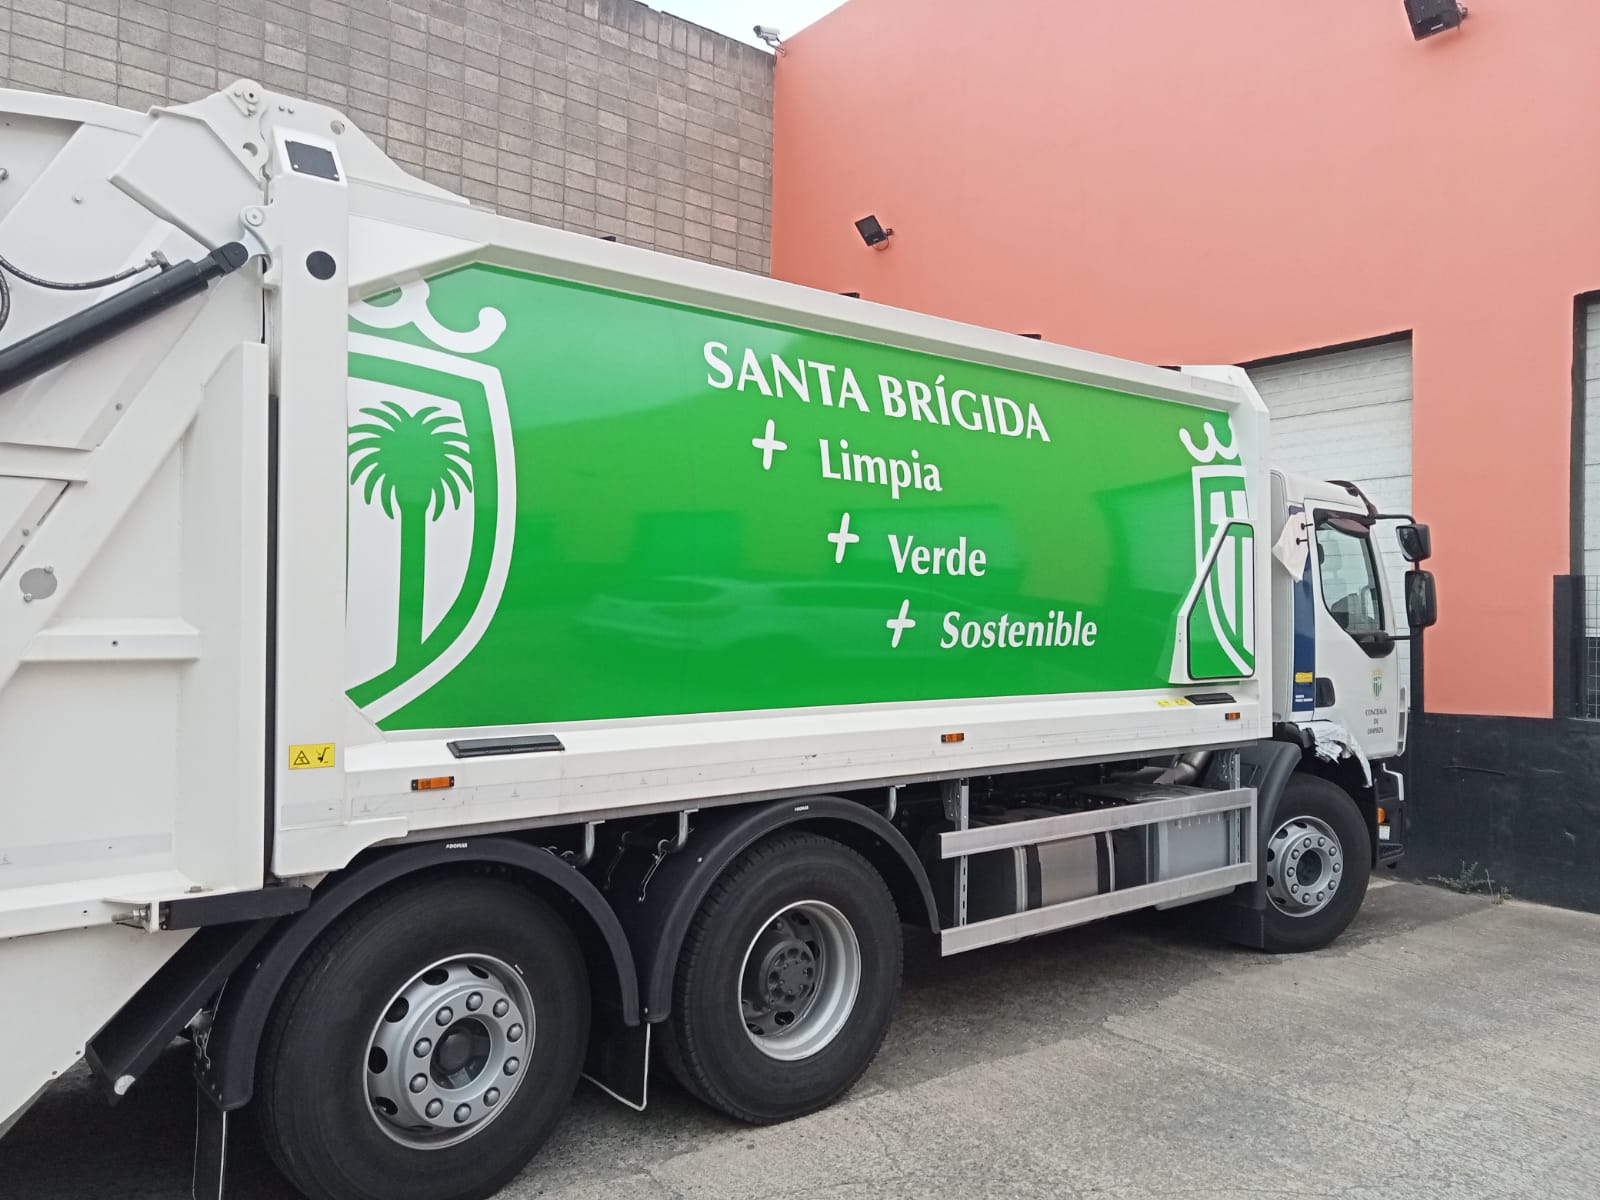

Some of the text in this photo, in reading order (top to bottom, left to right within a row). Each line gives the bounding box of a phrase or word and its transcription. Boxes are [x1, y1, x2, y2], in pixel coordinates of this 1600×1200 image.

[703, 341, 1051, 442] SANTA BRÍGIDA
[819, 438, 943, 500] Limpia
[887, 534, 987, 577] Verde
[940, 610, 1098, 649] Sostenible
